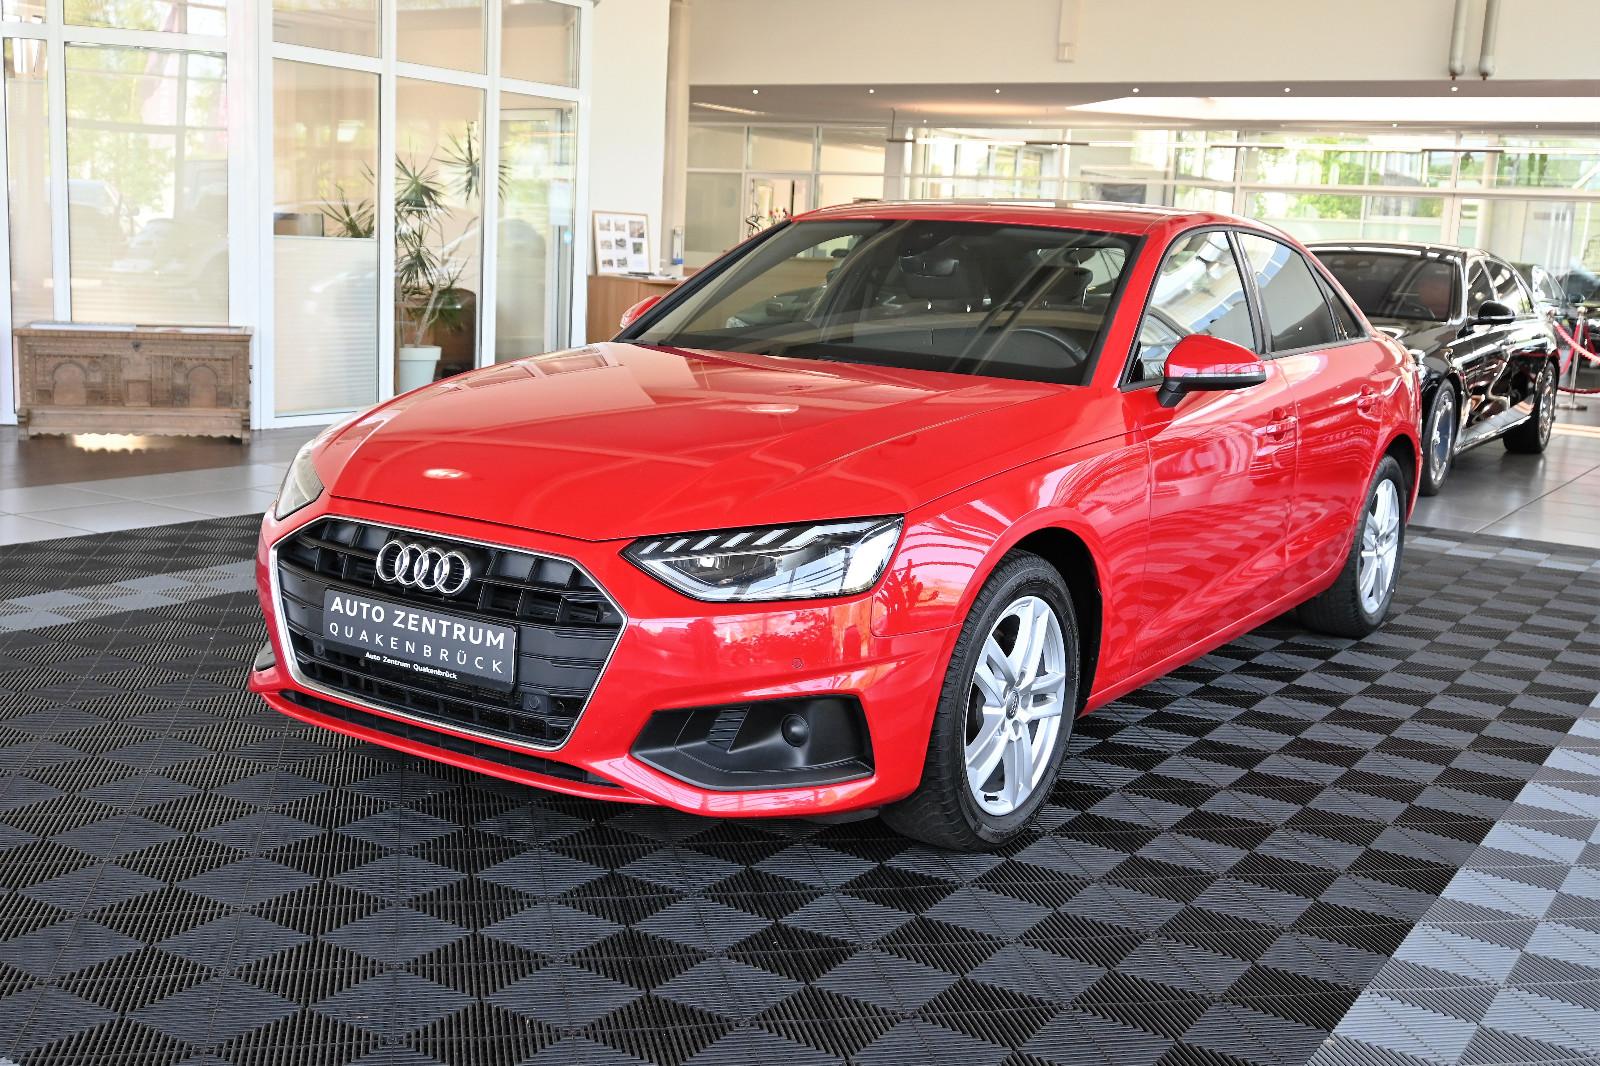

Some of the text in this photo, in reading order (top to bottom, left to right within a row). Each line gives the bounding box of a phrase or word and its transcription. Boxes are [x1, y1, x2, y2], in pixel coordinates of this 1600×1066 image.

[329, 622, 503, 674] QUAKENBRÜCK
[330, 596, 505, 650] AUTO ZENTRUM
[365, 651, 458, 680] Auto Zentrum Quakenbrück
